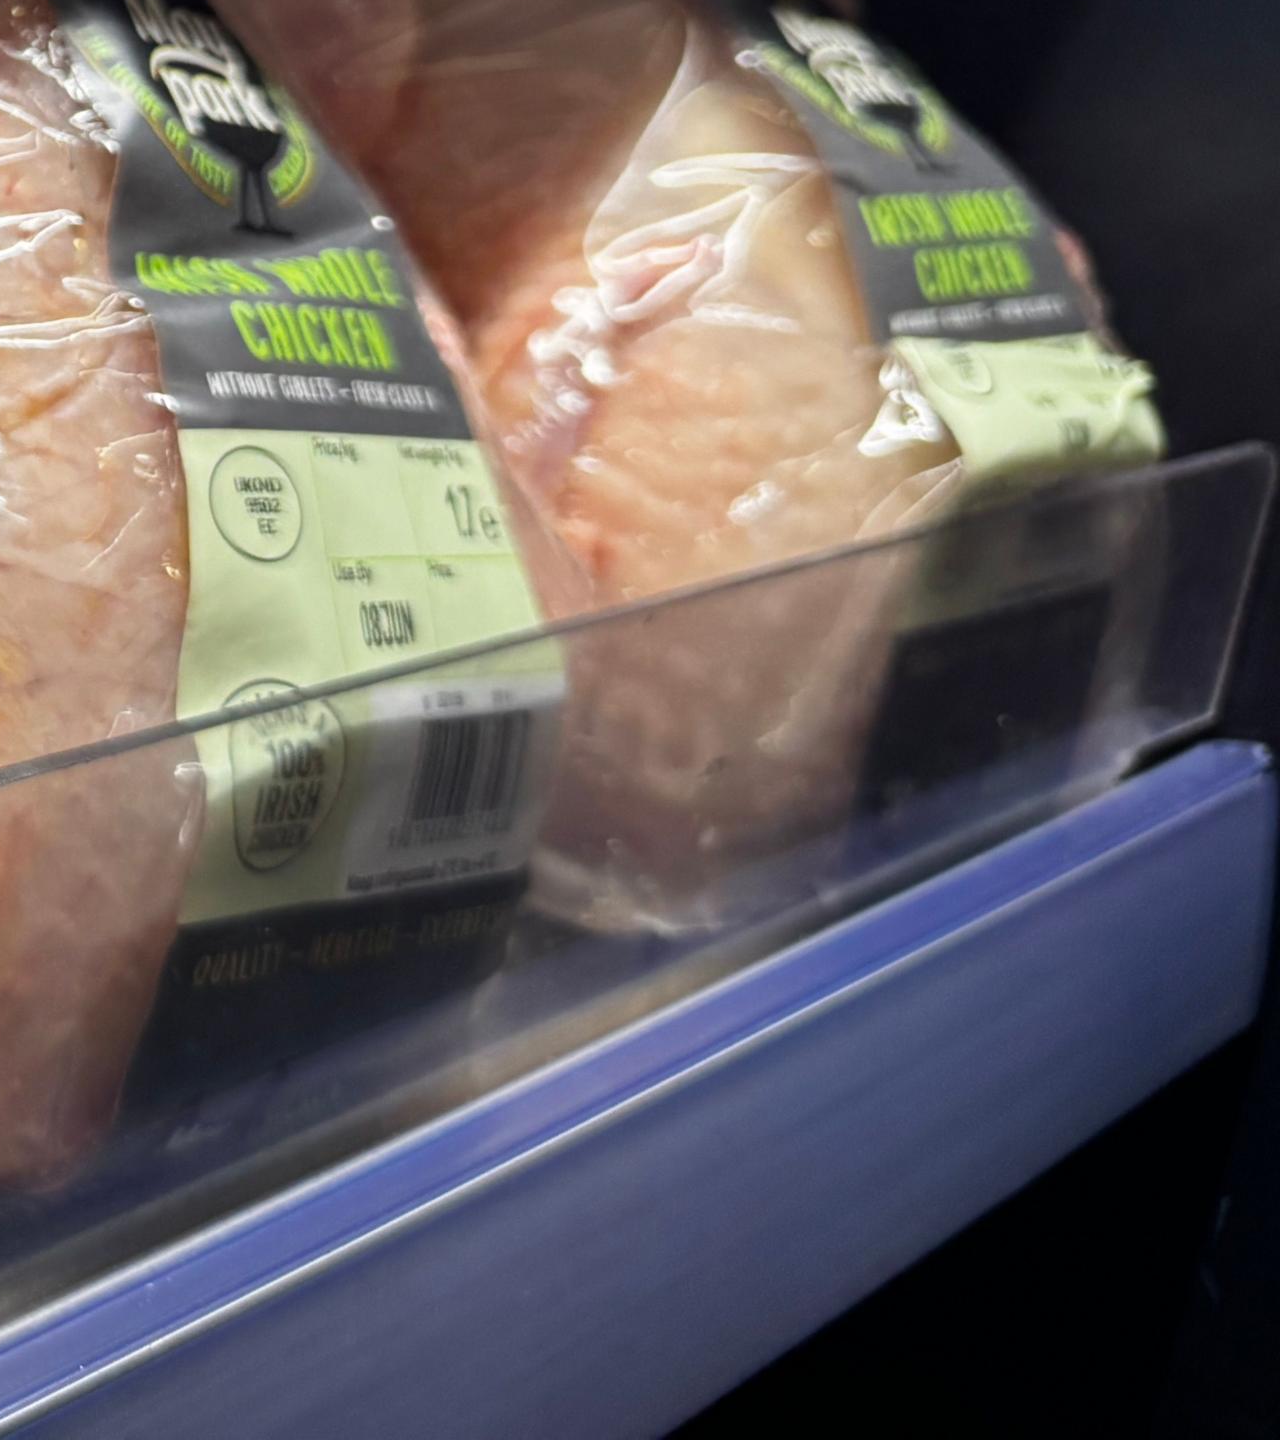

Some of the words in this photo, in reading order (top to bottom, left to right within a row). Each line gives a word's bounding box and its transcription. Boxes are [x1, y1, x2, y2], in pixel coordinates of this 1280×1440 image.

[230, 299, 398, 372] CHICKEN
[206, 371, 276, 400] WITHOUT
[359, 599, 416, 648] 08JUN
